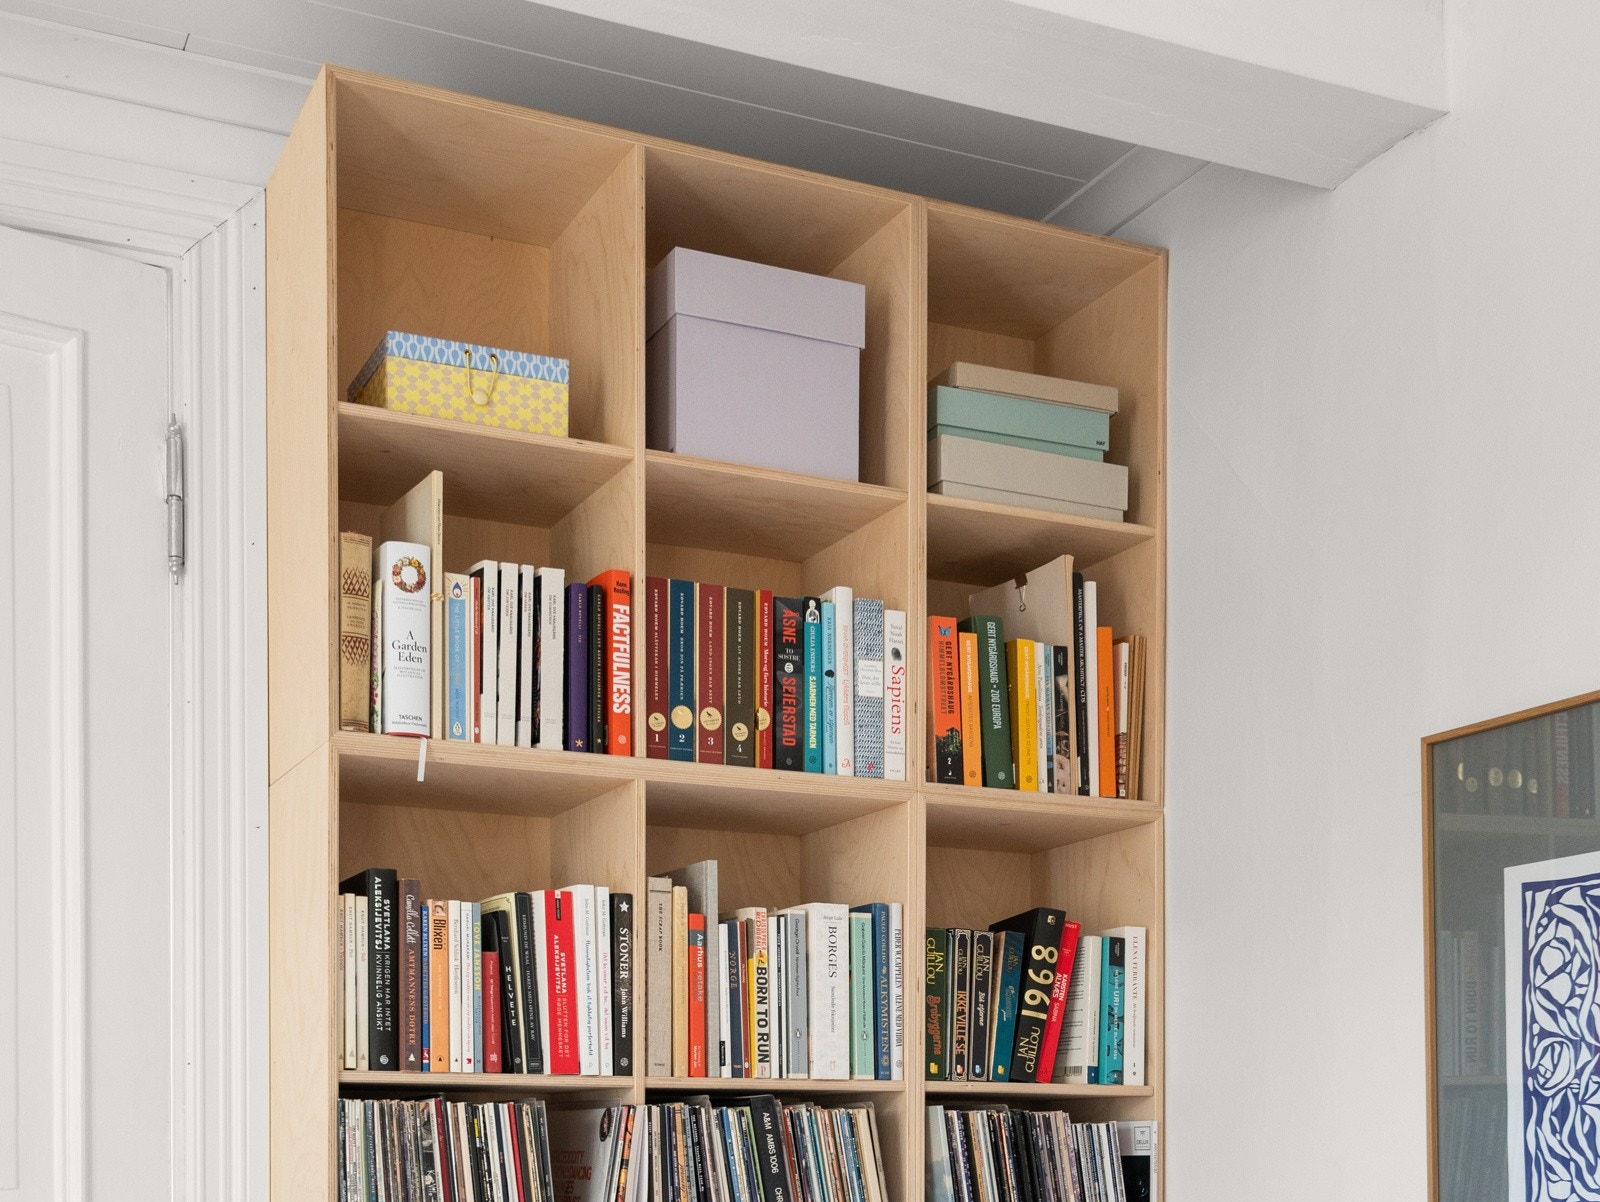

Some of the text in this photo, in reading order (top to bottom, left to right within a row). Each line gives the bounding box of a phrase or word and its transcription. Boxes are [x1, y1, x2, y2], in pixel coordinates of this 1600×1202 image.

[614, 587, 630, 596] Rosling
[392, 640, 428, 654] Garden
[406, 631, 414, 640] A
[782, 609, 799, 644] ÅSNE
[945, 642, 953, 658] GERT
[398, 652, 422, 664] Eden
[612, 604, 630, 714] FACTFULNESS
[987, 622, 1001, 729] GERT NYGÅRDSHAUG ZOO EUROPA
[782, 677, 796, 746] SEIERSTAD
[809, 676, 817, 748] SJARMEN MED TARMEN
[887, 665, 905, 735] Sapiens
[679, 734, 684, 742] 2
[708, 737, 714, 745] 3
[374, 877, 382, 950] ALEKSIJEVITSJ
[433, 919, 446, 950] Blixen
[620, 927, 629, 979] STONER
[828, 926, 837, 978] BORGES
[894, 928, 902, 950] PEDER
[927, 938, 936, 984] GUILLOU
[934, 952, 944, 972] JAN
[696, 934, 704, 1002] Aarhus retake
[729, 952, 737, 989] NORGE
[894, 956, 902, 989] CAPPELEN
[1021, 944, 1058, 1020] 1968
[1052, 972, 1060, 998] ALNÆS
[1059, 974, 1068, 1001] KARSTEN
[408, 949, 416, 1045] AMTMANNENS DØTRE
[506, 966, 517, 1026] HELVETE
[620, 988, 628, 1038] John Williams
[756, 967, 769, 1063] BORN TO RUN
[880, 975, 889, 1052] ALKYMISTEN
[927, 995, 942, 1055] Brobyggerne
[956, 991, 966, 1055] IKKE VILLE SE
[1017, 1037, 1030, 1058] JAN
[1025, 1027, 1041, 1072] GUILLOU
[763, 1112, 778, 1173] A&M AMBS 1006
